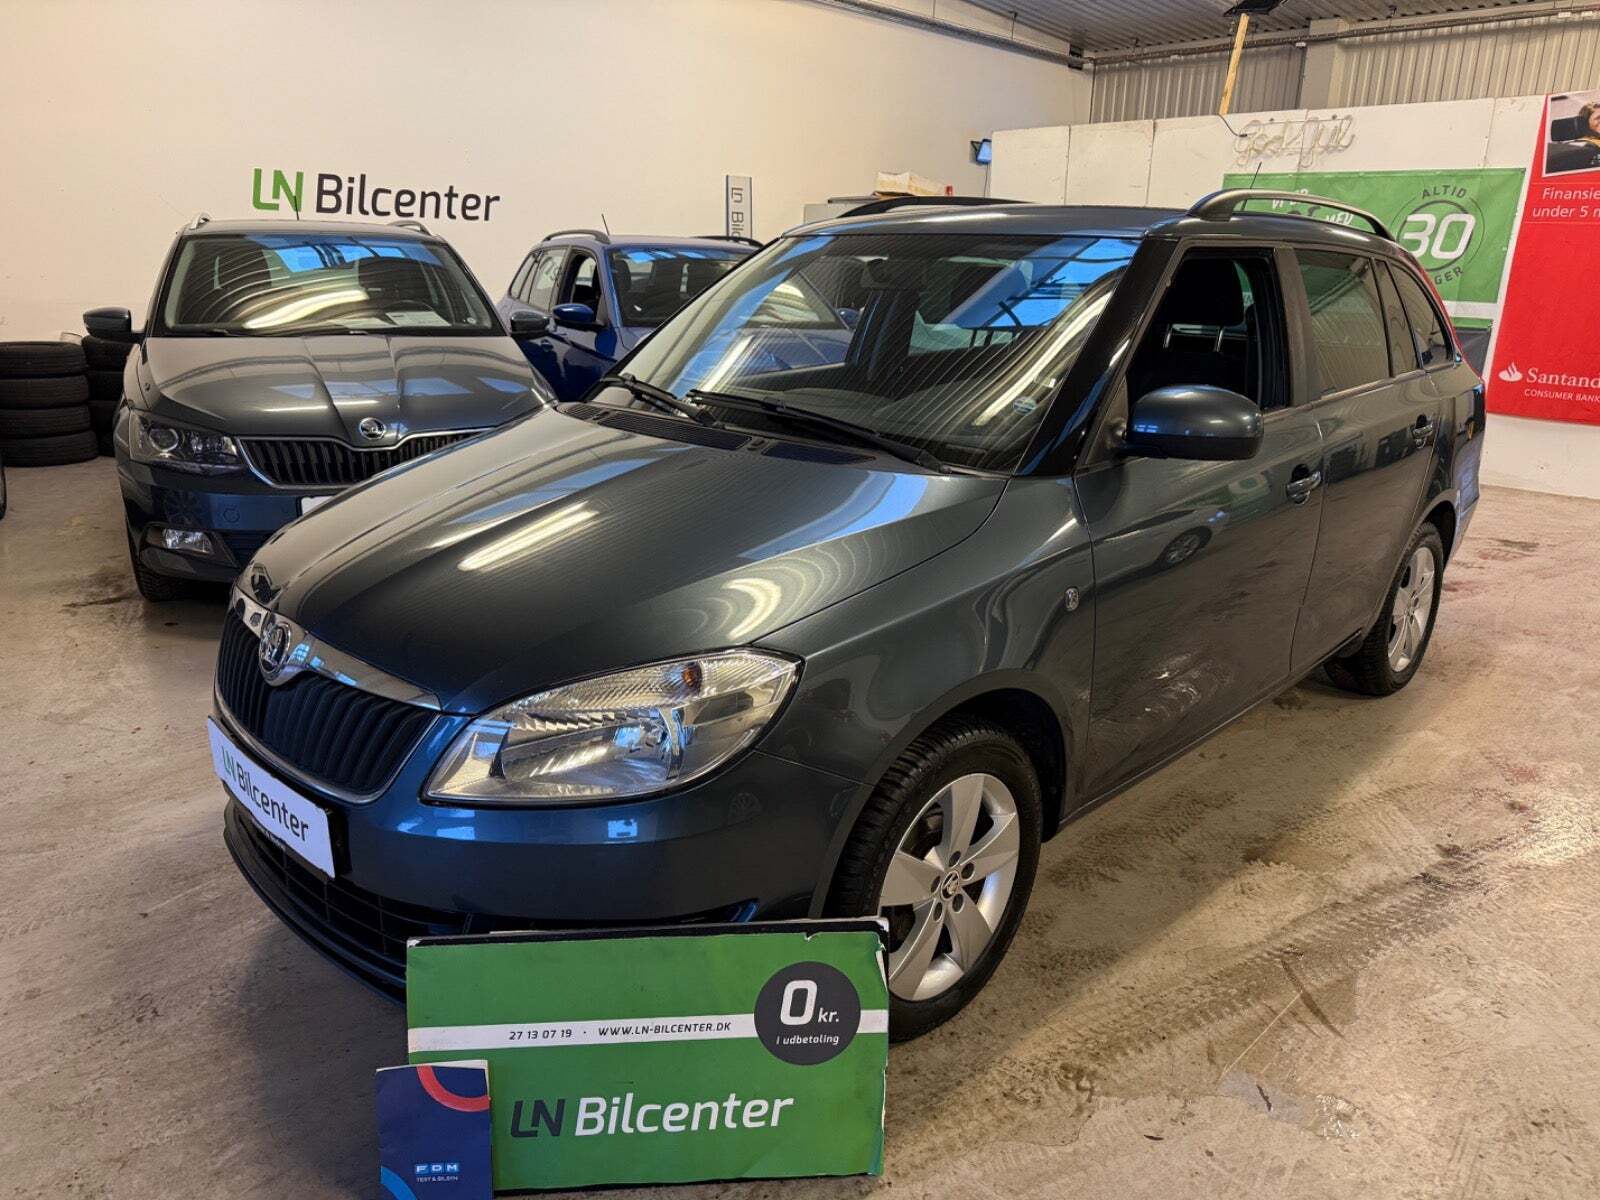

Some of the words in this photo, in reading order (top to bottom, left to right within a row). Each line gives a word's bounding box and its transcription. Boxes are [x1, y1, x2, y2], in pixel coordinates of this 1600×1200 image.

[252, 168, 304, 212] LN
[315, 173, 500, 221] Bilcenter
[1421, 184, 1467, 199] ALTID
[1532, 204, 1575, 218] under
[1579, 205, 1590, 218] 5
[1403, 213, 1476, 259] 30
[1526, 367, 1600, 388] Santand
[1524, 388, 1574, 400] CONSUMER
[1575, 392, 1600, 402] BANK
[221, 746, 237, 782] LN
[236, 763, 310, 842] Bilcenter
[780, 980, 818, 1026] 0
[817, 1007, 840, 1023] kr.
[509, 1031, 523, 1041] 27
[527, 1031, 538, 1040] 13
[542, 1030, 556, 1039] 07
[560, 1029, 572, 1038] 19
[598, 1022, 732, 1036] WWW.LN-BILCENTER.DK
[782, 1034, 840, 1046] udbetaling
[510, 1098, 566, 1138] LN
[574, 1092, 794, 1137] Bilcenter
[416, 1164, 457, 1173] FDM
